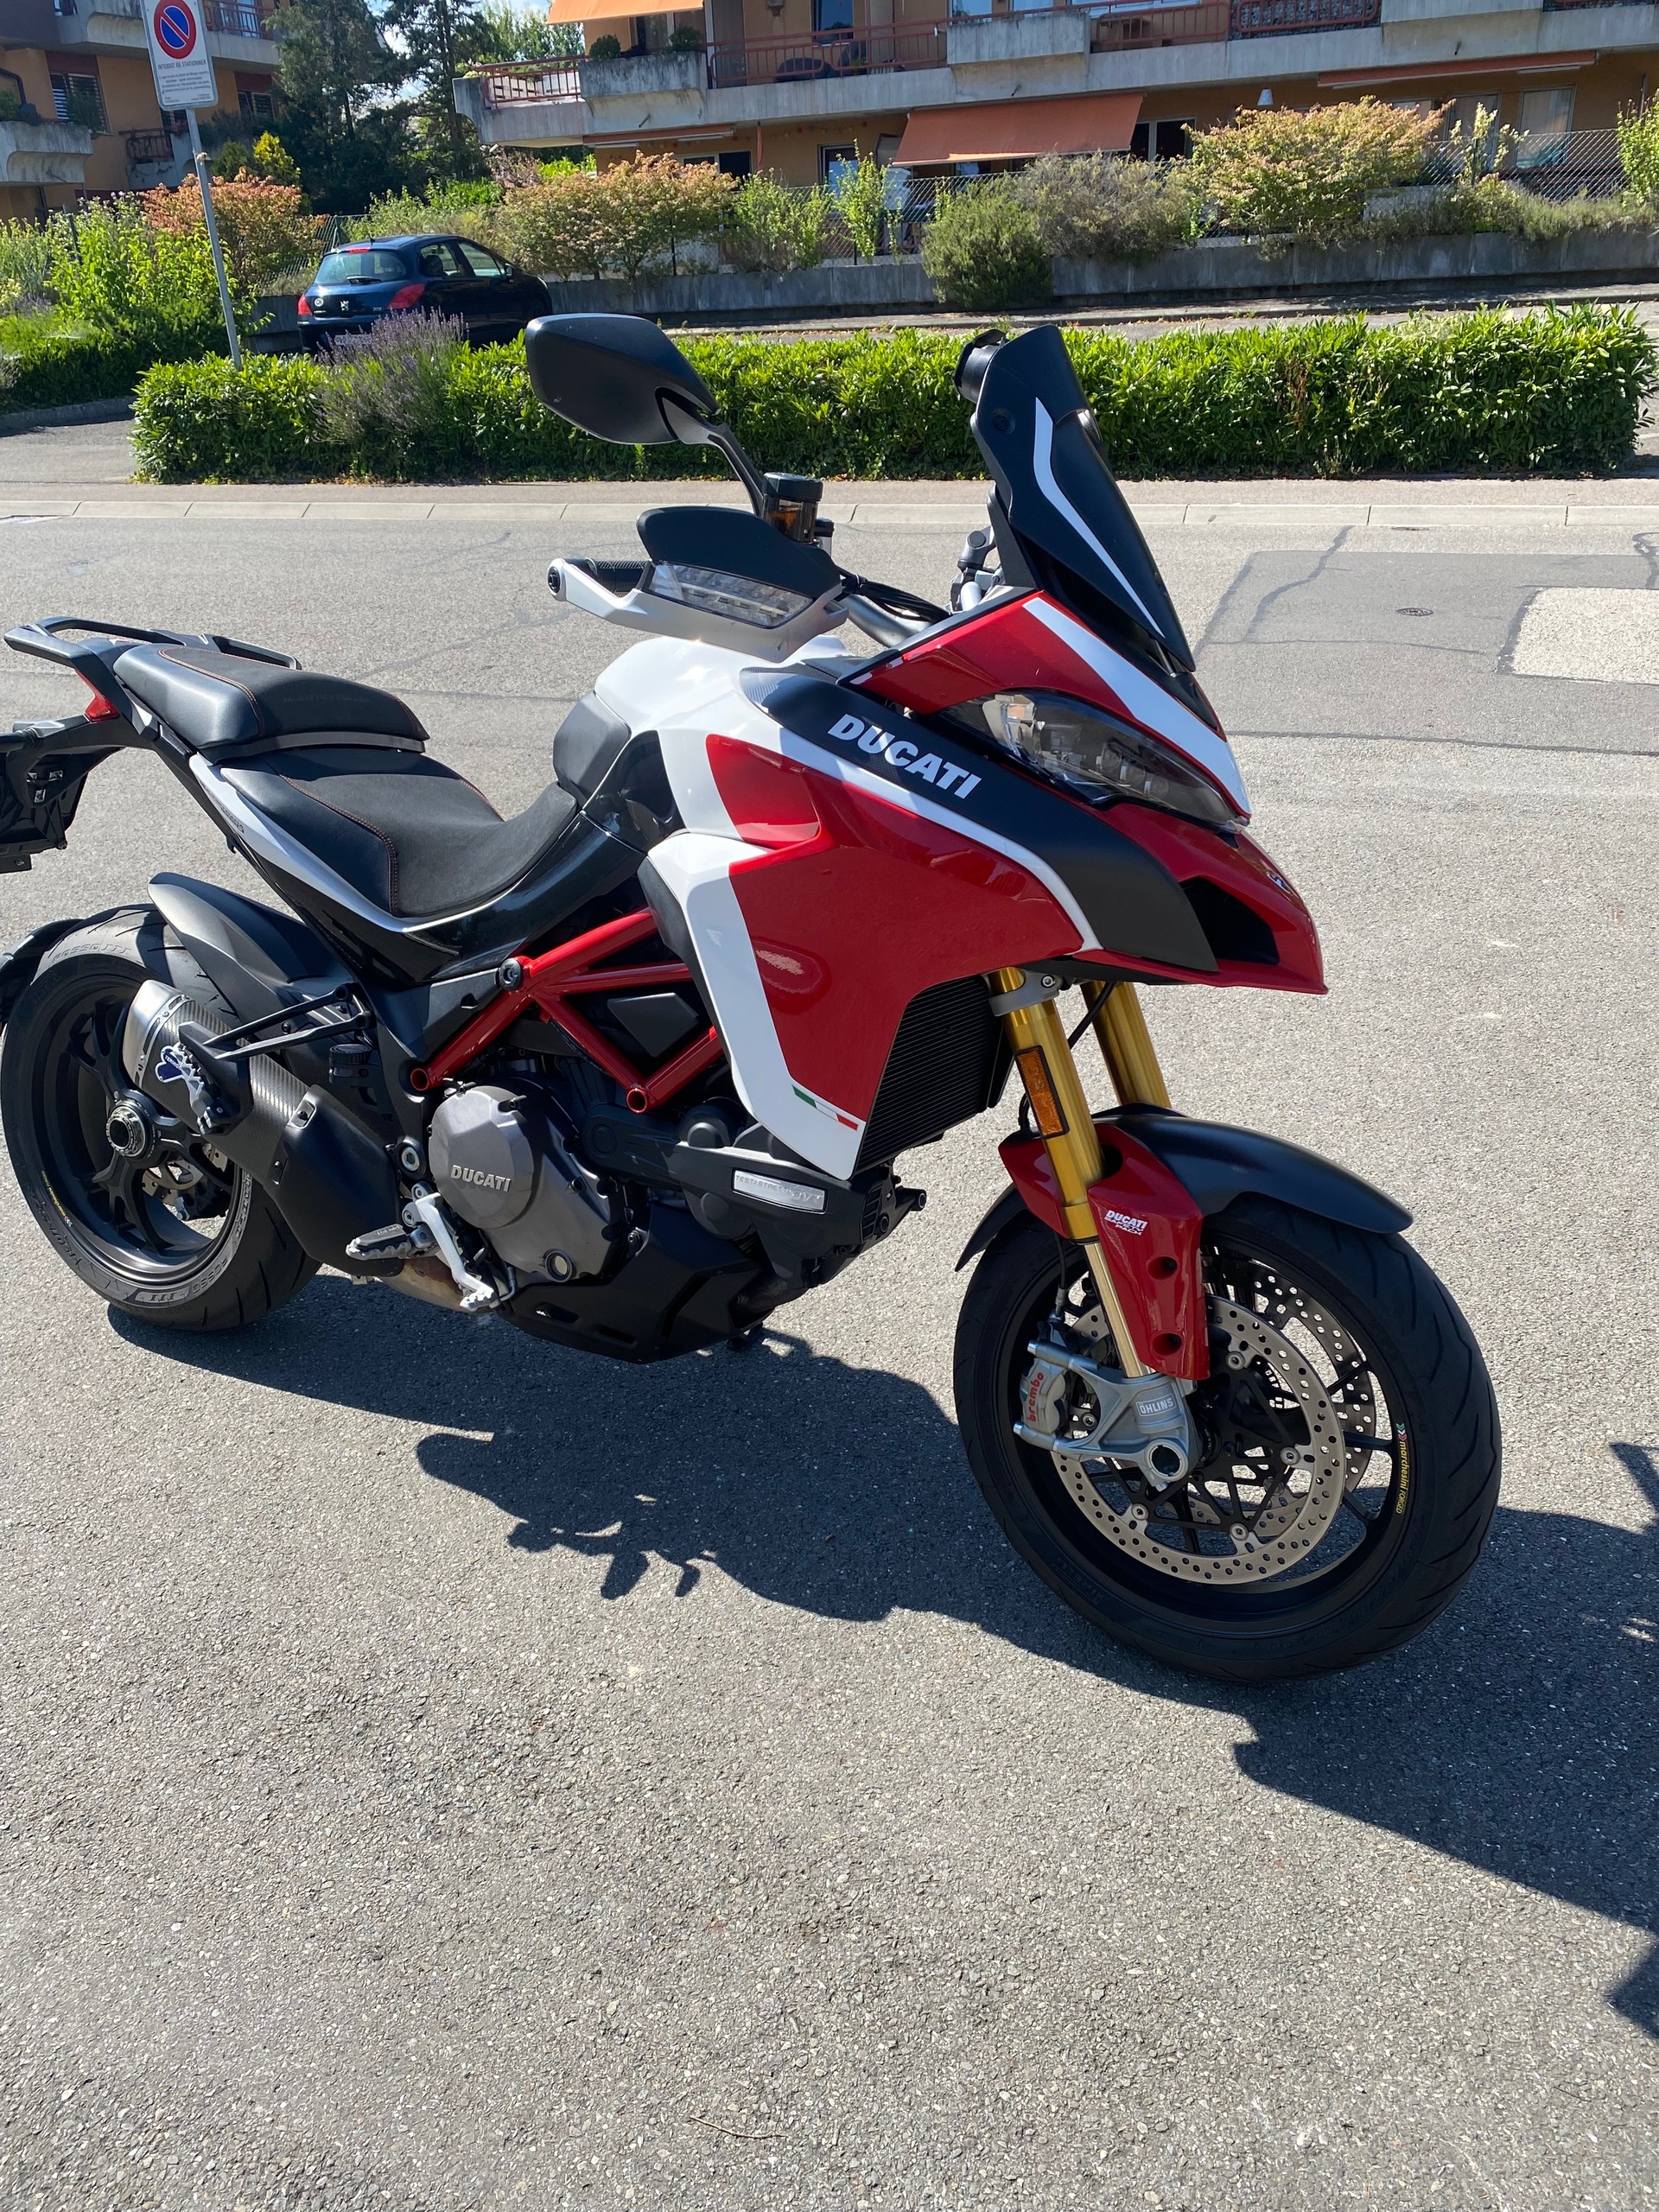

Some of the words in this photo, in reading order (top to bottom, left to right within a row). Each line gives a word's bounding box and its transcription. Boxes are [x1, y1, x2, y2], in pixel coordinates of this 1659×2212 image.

[181, 59, 207, 67] STATIONNER
[827, 714, 982, 799] DUCATI
[450, 1164, 512, 1192] DUCATI
[1104, 1216, 1144, 1232] SAFETY
[1105, 1209, 1148, 1230] DUCATI
[1115, 1223, 1143, 1236] PACK
[1026, 1371, 1045, 1422] brembo
[1139, 1396, 1174, 1414] ÖHLINS
[1398, 1440, 1410, 1491] marchesini
[1395, 1489, 1407, 1515] FORGED
